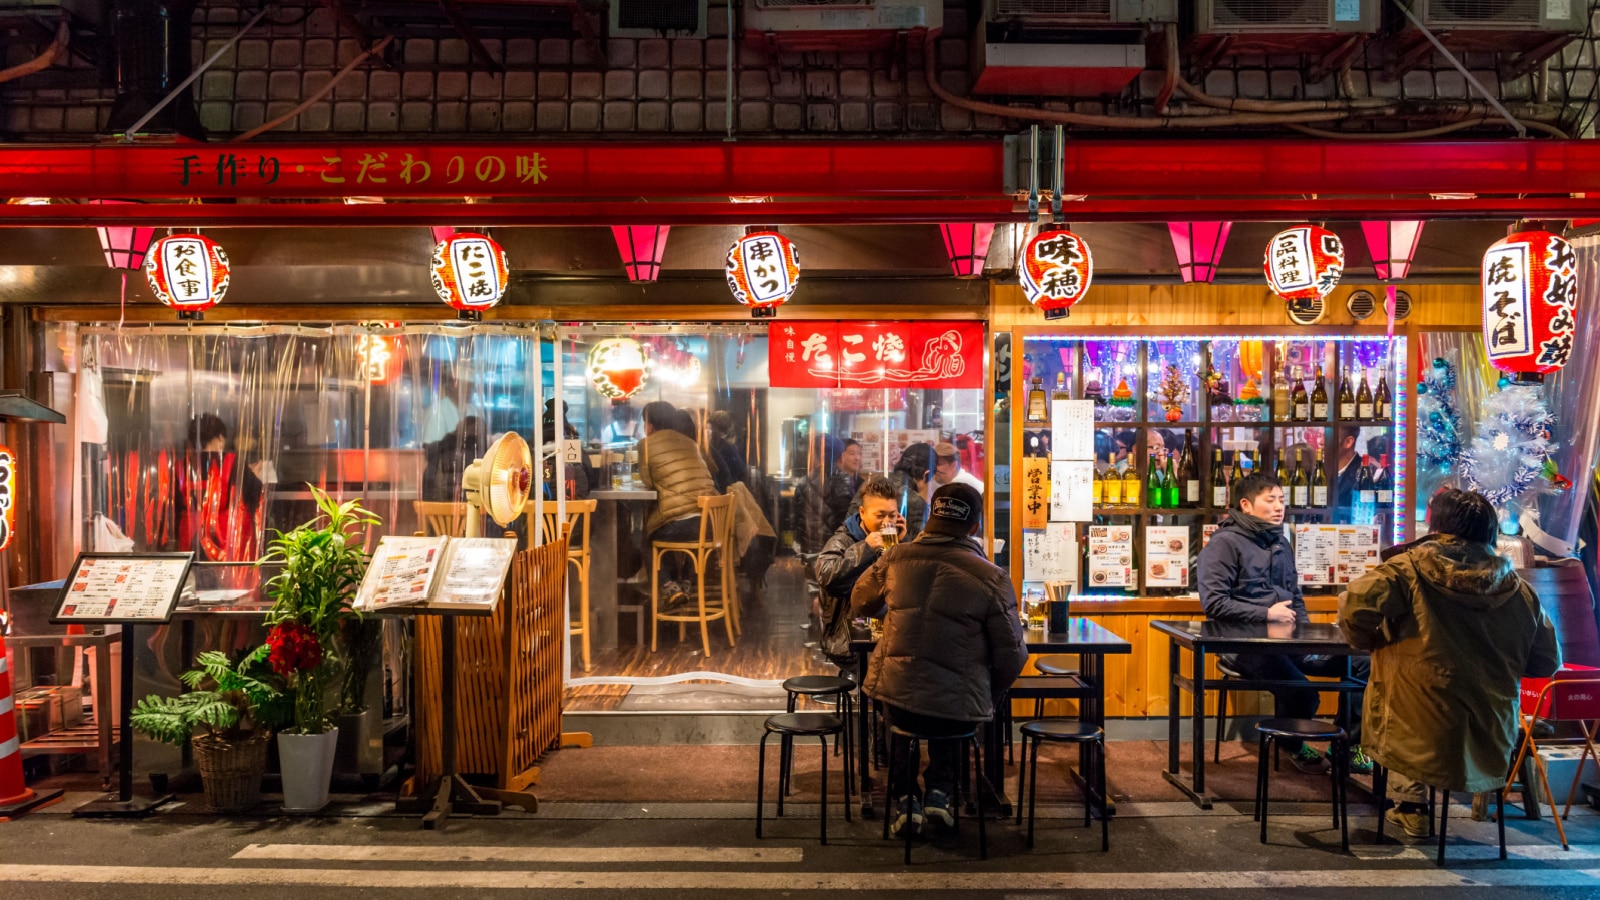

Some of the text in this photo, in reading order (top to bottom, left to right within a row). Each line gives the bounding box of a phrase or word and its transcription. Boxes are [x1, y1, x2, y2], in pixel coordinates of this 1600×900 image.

[171, 152, 549, 186] 手作り・こだわりの味
[173, 244, 201, 297] お食事
[460, 245, 493, 297] たこ焼
[749, 241, 779, 293] 串かつ
[1038, 235, 1081, 297] 味穂
[1276, 233, 1303, 284] 一品料理
[1487, 256, 1521, 348] 焼そば
[1539, 238, 1577, 366] お好み焼
[783, 326, 796, 363] 味自慢
[567, 442, 577, 461] 入口
[1027, 468, 1043, 515] 営業中
